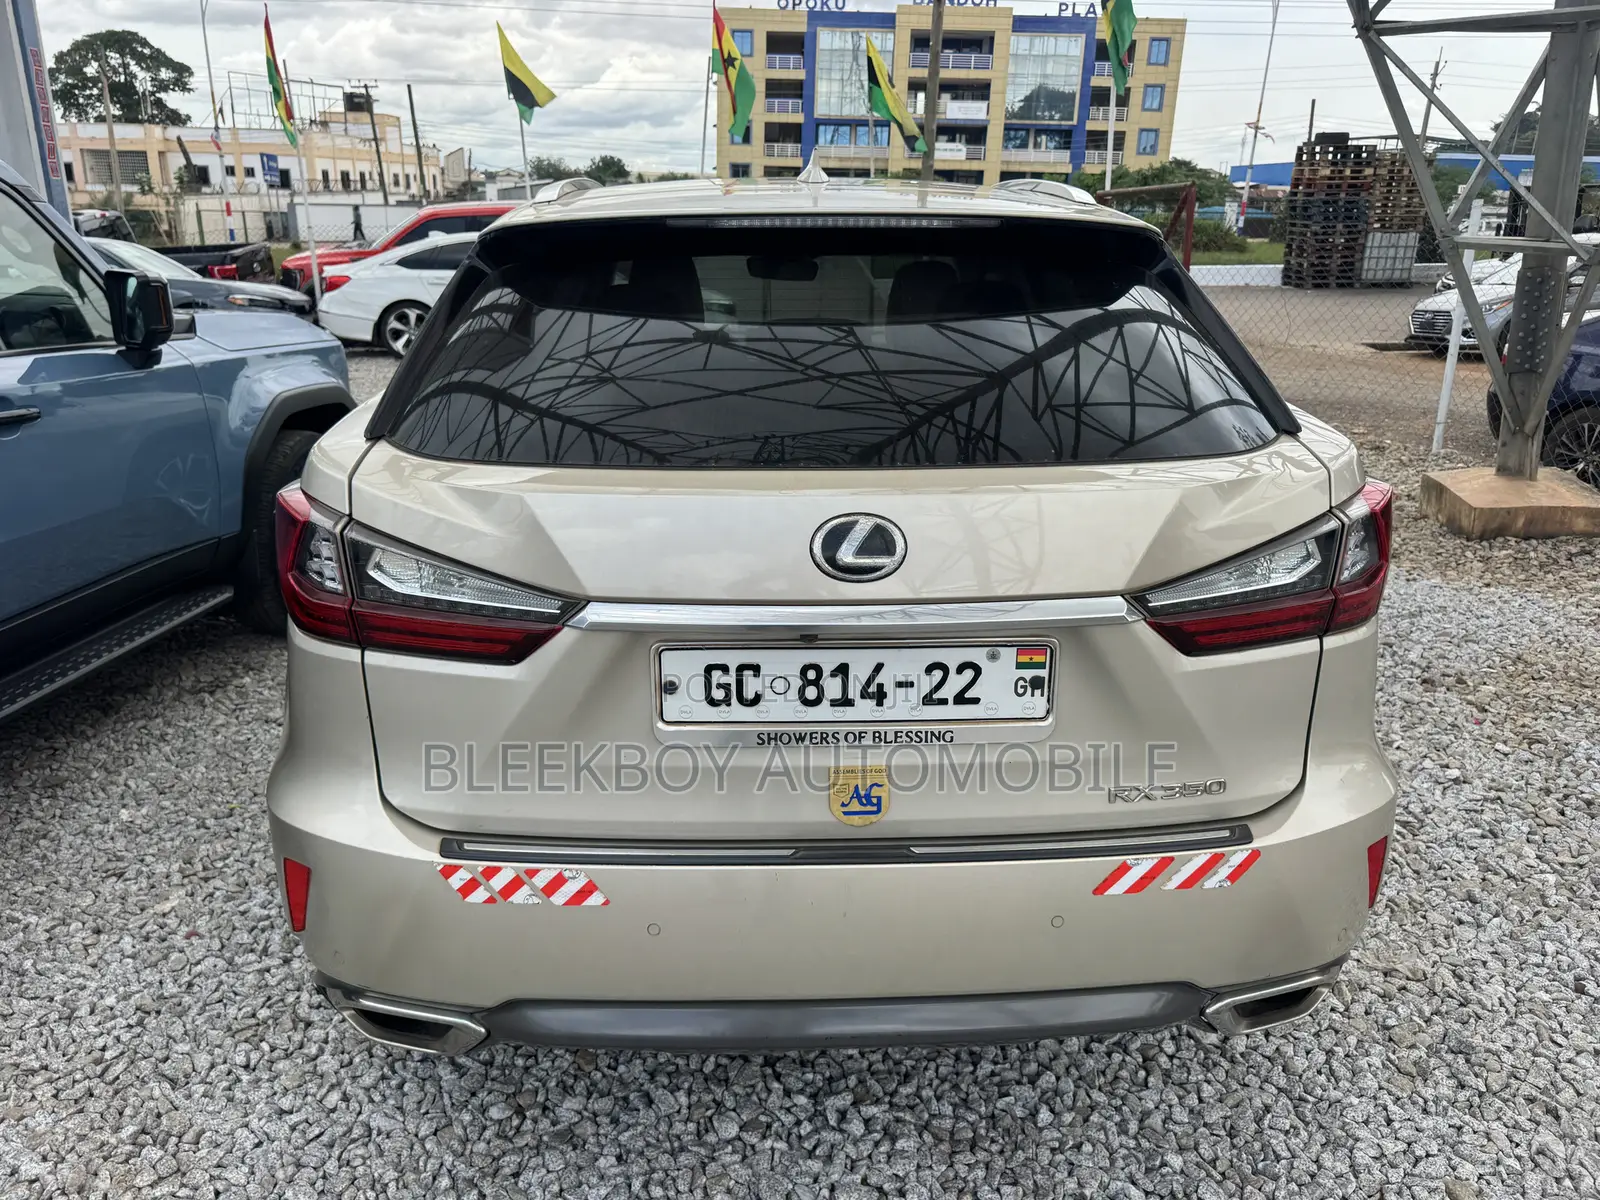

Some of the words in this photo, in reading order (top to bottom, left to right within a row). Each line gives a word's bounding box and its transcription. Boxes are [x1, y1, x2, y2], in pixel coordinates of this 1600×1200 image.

[777, 0, 846, 11] OPOKU
[703, 662, 763, 708] GC
[797, 660, 983, 708] 814-22
[756, 731, 841, 746] SHOWERS
[843, 730, 868, 745] OF
[872, 730, 954, 745] BLESSING
